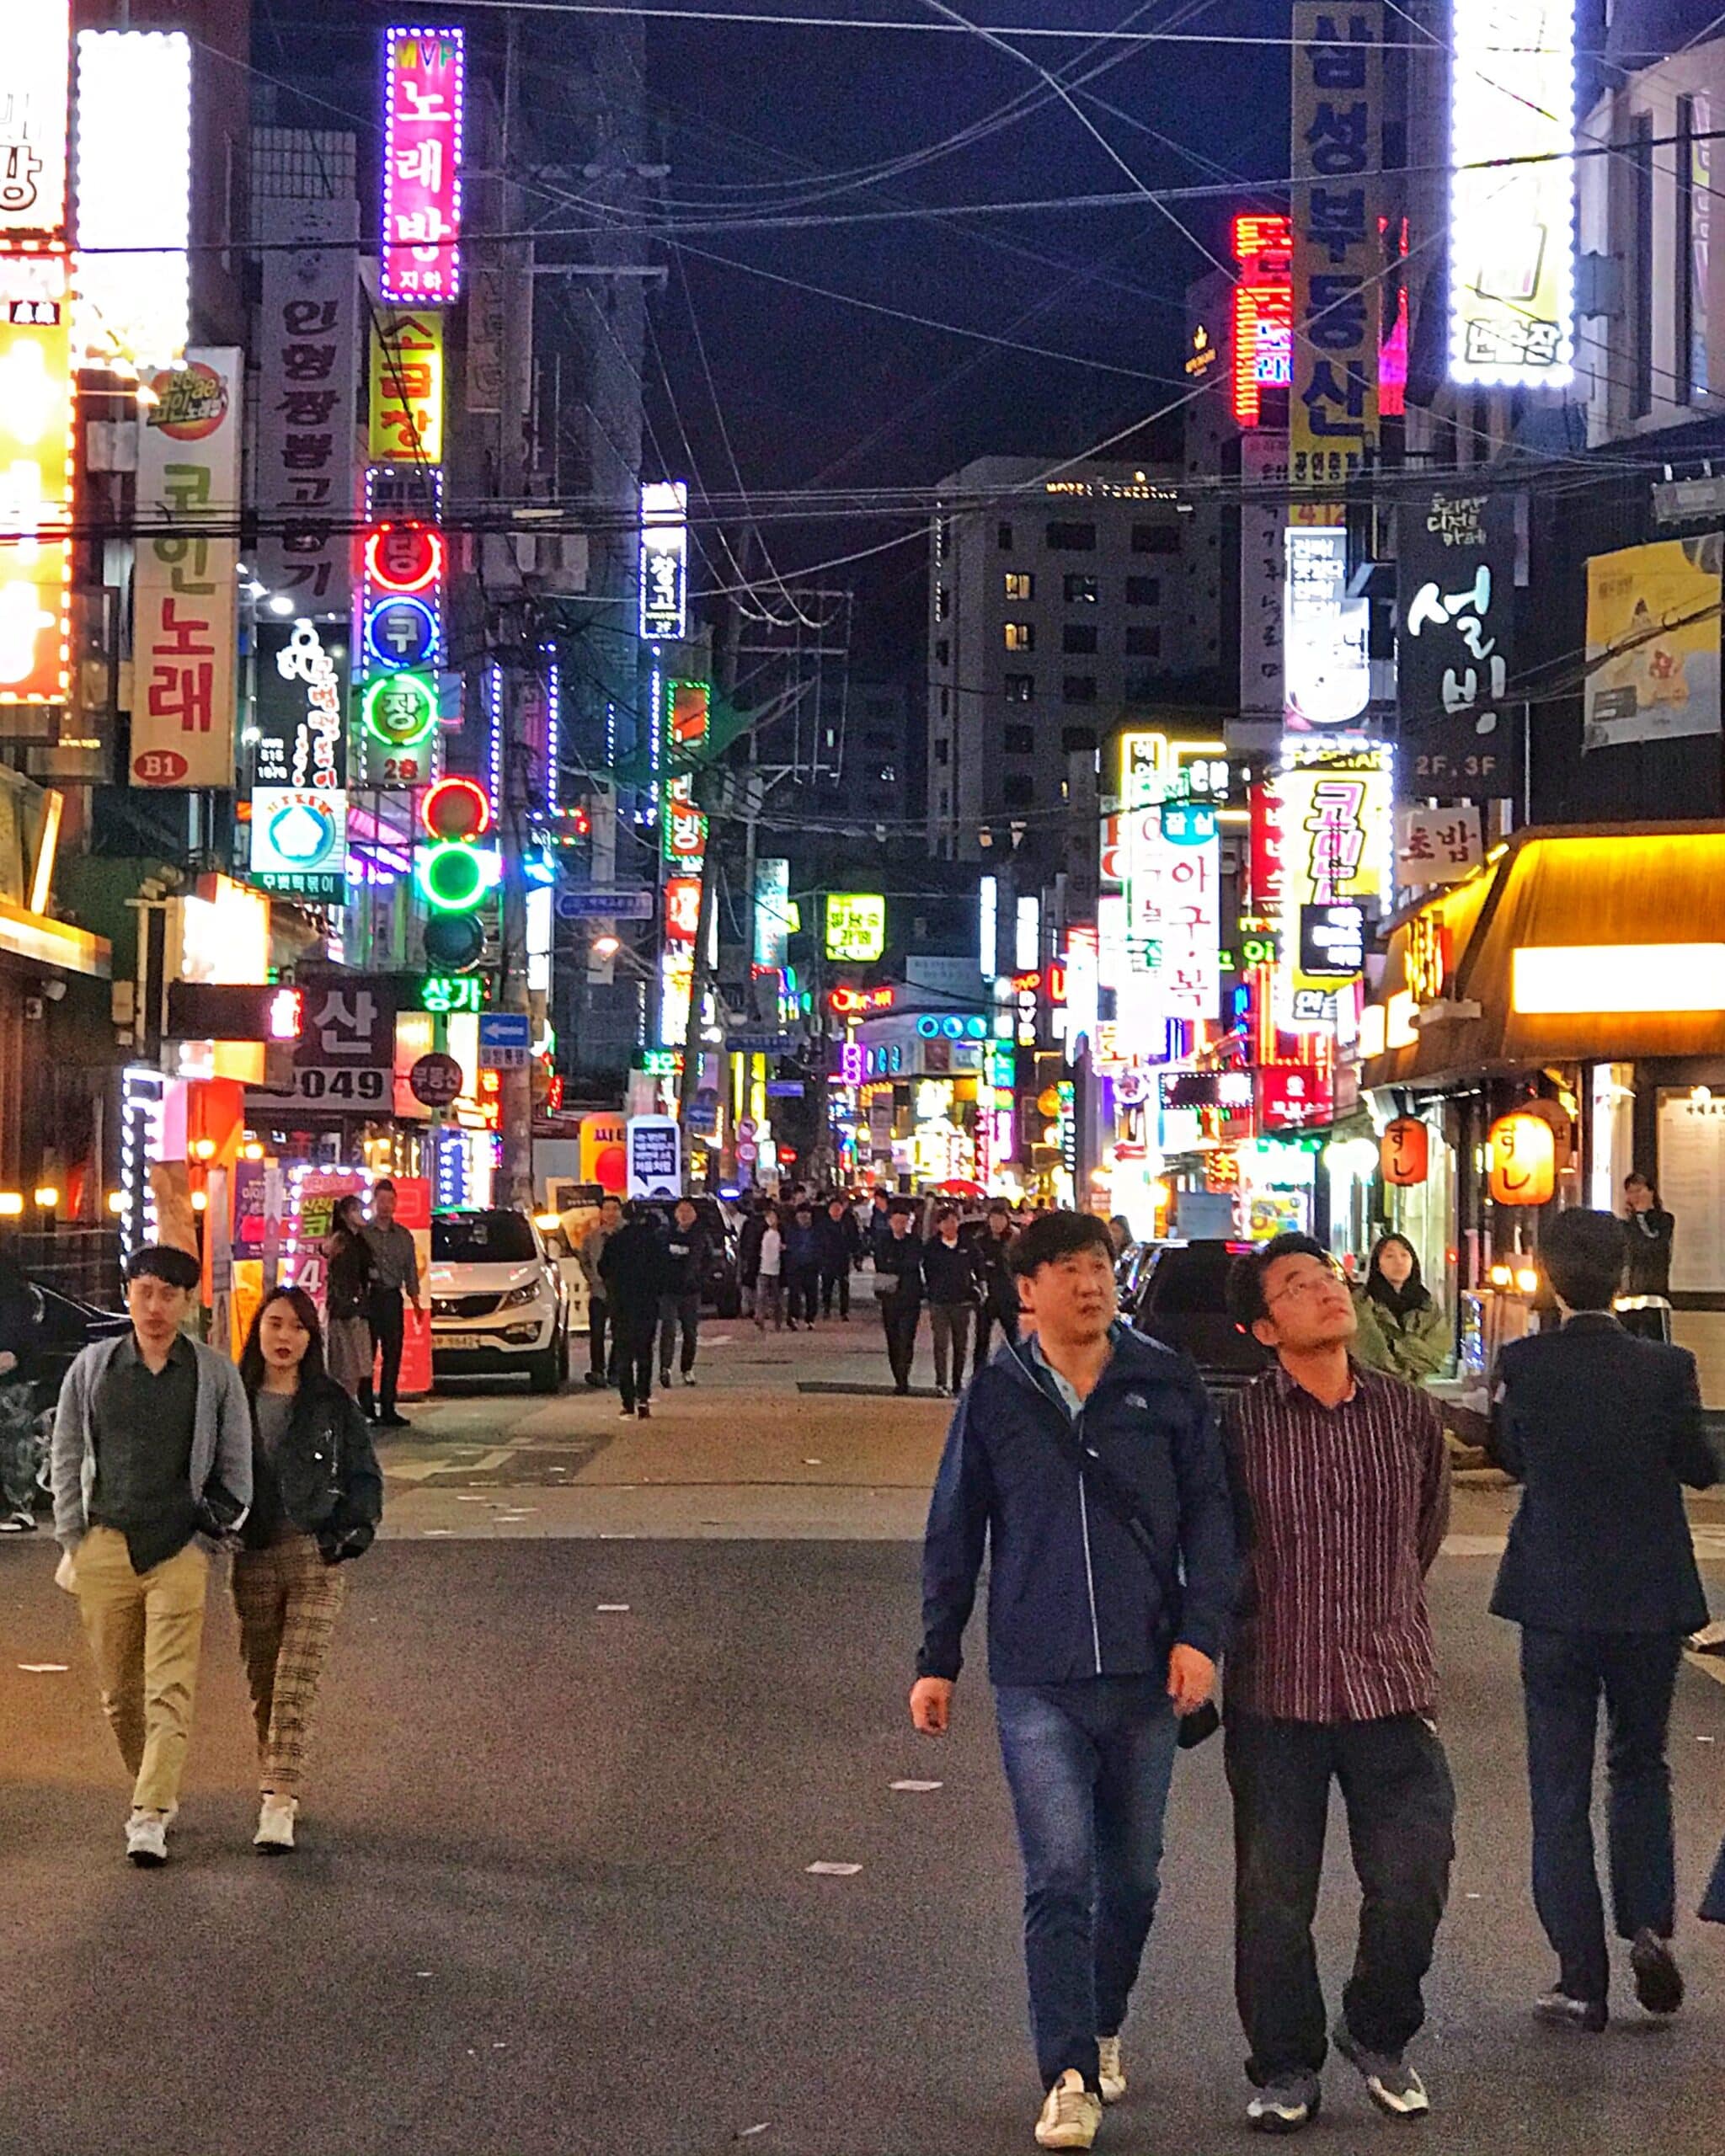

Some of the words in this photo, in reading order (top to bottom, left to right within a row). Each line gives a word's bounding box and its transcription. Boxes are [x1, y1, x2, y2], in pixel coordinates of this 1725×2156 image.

[397, 40, 454, 69] MVP
[394, 80, 451, 262] 노래방
[398, 270, 442, 291] 지하
[148, 463, 216, 733] 코인노래
[144, 753, 175, 776] B1
[422, 978, 482, 1011] 상가
[312, 991, 377, 1054] 산
[1391, 1129, 1415, 1177] すし
[1499, 1127, 1530, 1191] すし
